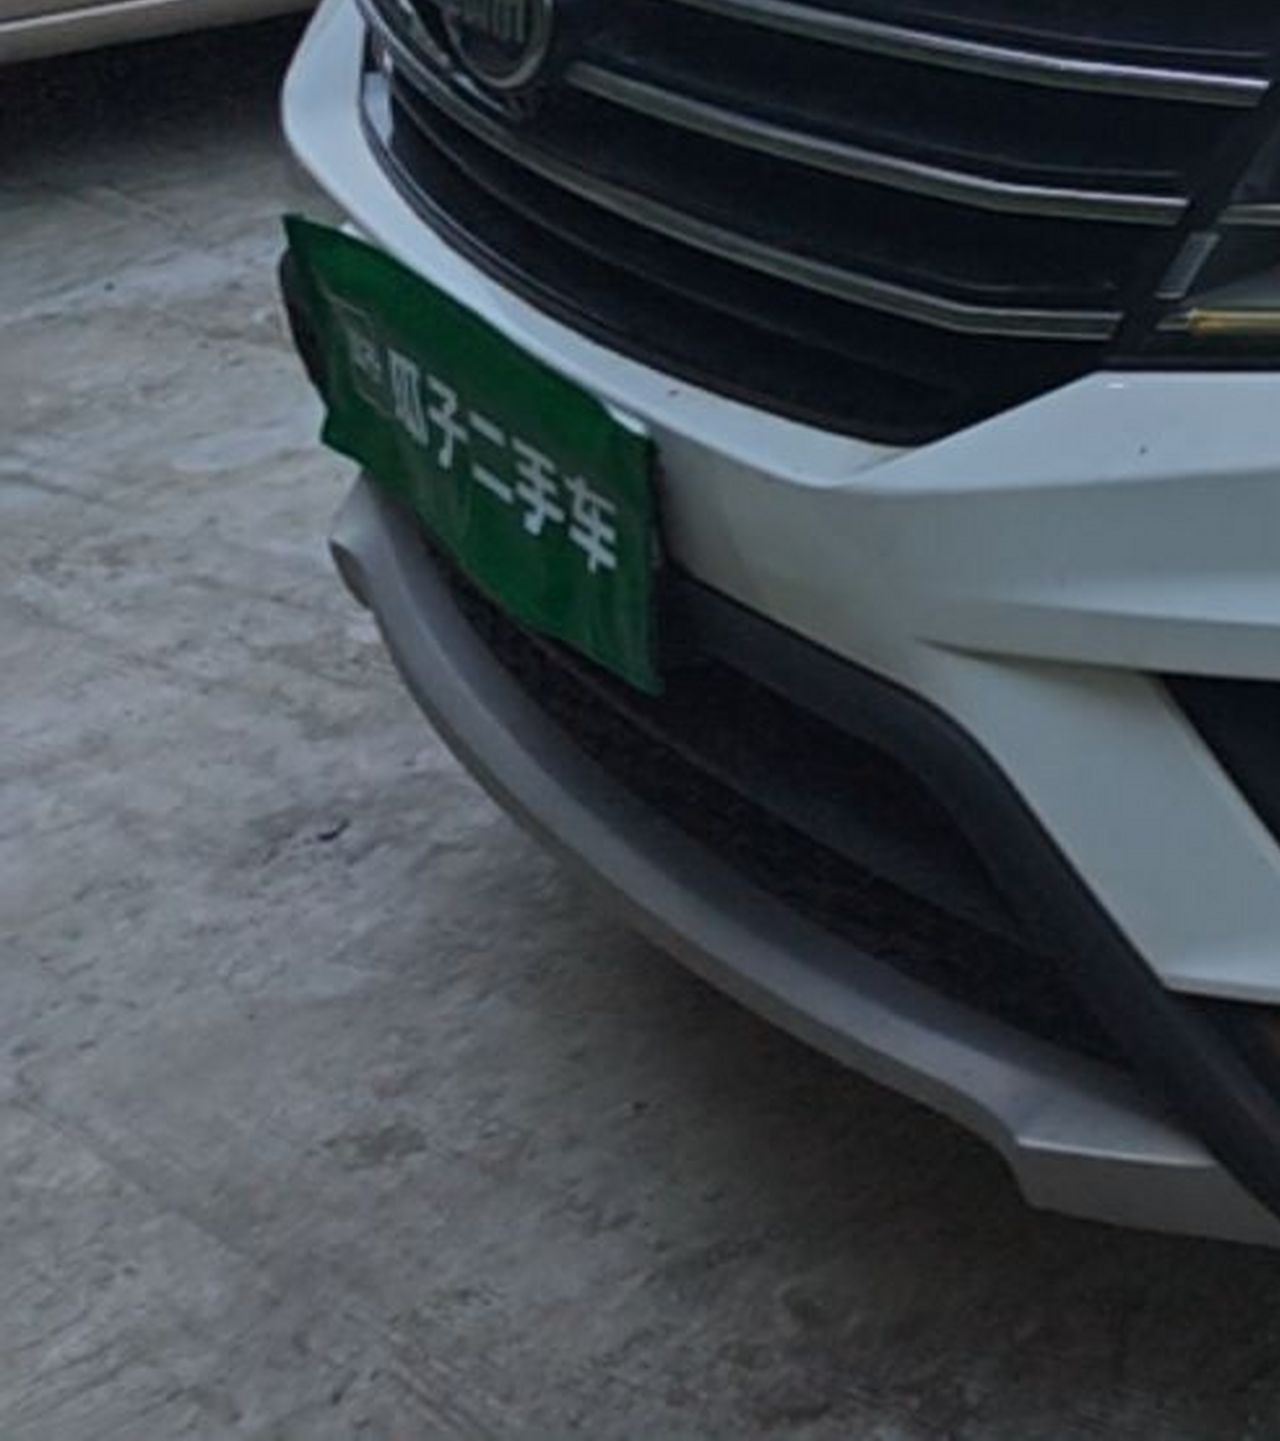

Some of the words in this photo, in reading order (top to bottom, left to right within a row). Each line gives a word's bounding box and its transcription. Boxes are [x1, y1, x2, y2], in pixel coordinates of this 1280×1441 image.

[386, 346, 618, 574] 瓜子二手车
